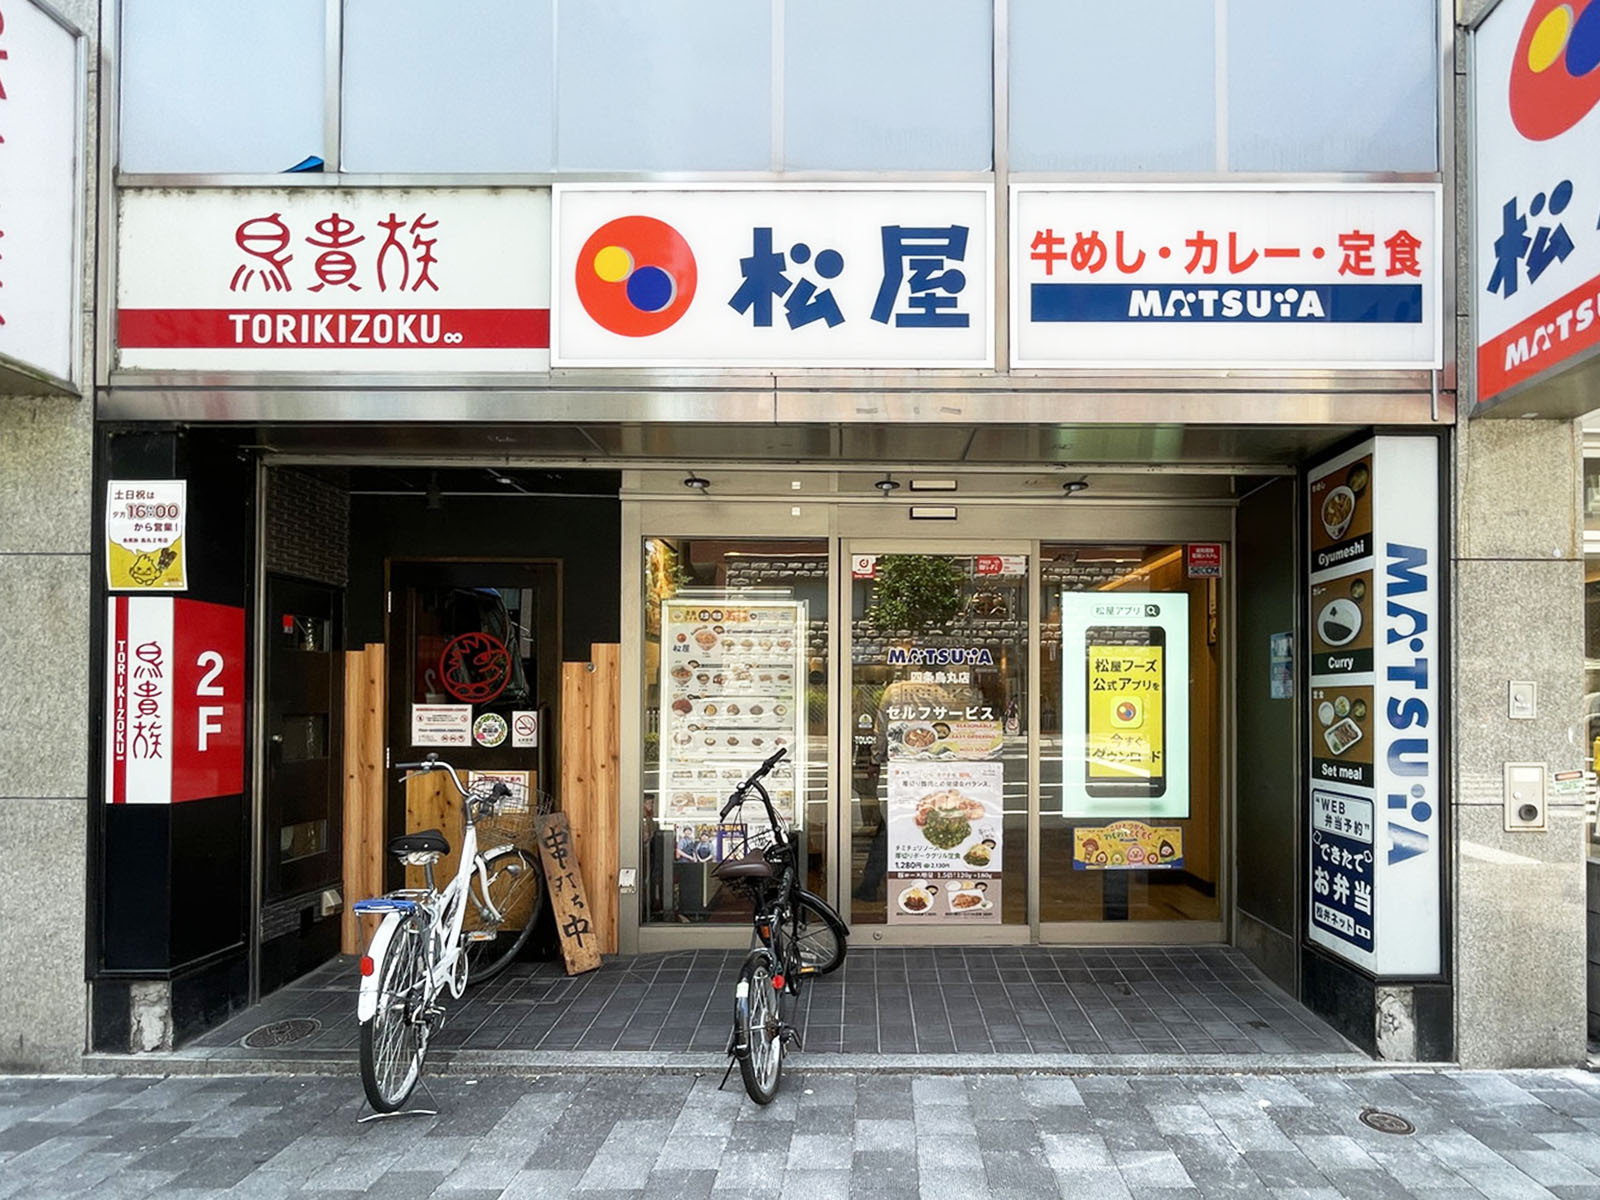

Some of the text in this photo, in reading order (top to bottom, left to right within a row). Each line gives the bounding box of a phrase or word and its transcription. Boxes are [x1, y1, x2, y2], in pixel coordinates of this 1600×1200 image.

[1030, 229, 1423, 277] 牛めし・カレー・定食
[1486, 179, 1600, 300] 松
[727, 223, 970, 330] 松屋
[1128, 288, 1325, 318] MATSUYA
[1504, 293, 1600, 371] MATS
[114, 489, 155, 500] 土日祝は
[1318, 539, 1365, 567] Gyumeshi
[887, 647, 994, 665] MATSUYA
[1095, 658, 1157, 673] 松屋フーズ
[1328, 656, 1354, 670] Curry
[1093, 677, 1160, 691] 公式アプリを
[886, 705, 994, 720] セルフサービス
[1386, 542, 1433, 866] MATSUYA
[1092, 747, 1161, 763] ダウンロド
[1321, 763, 1363, 781] Set meal
[1319, 843, 1364, 873] できたて
[543, 826, 590, 948] 串打ち中
[1314, 866, 1371, 916] お弁当
